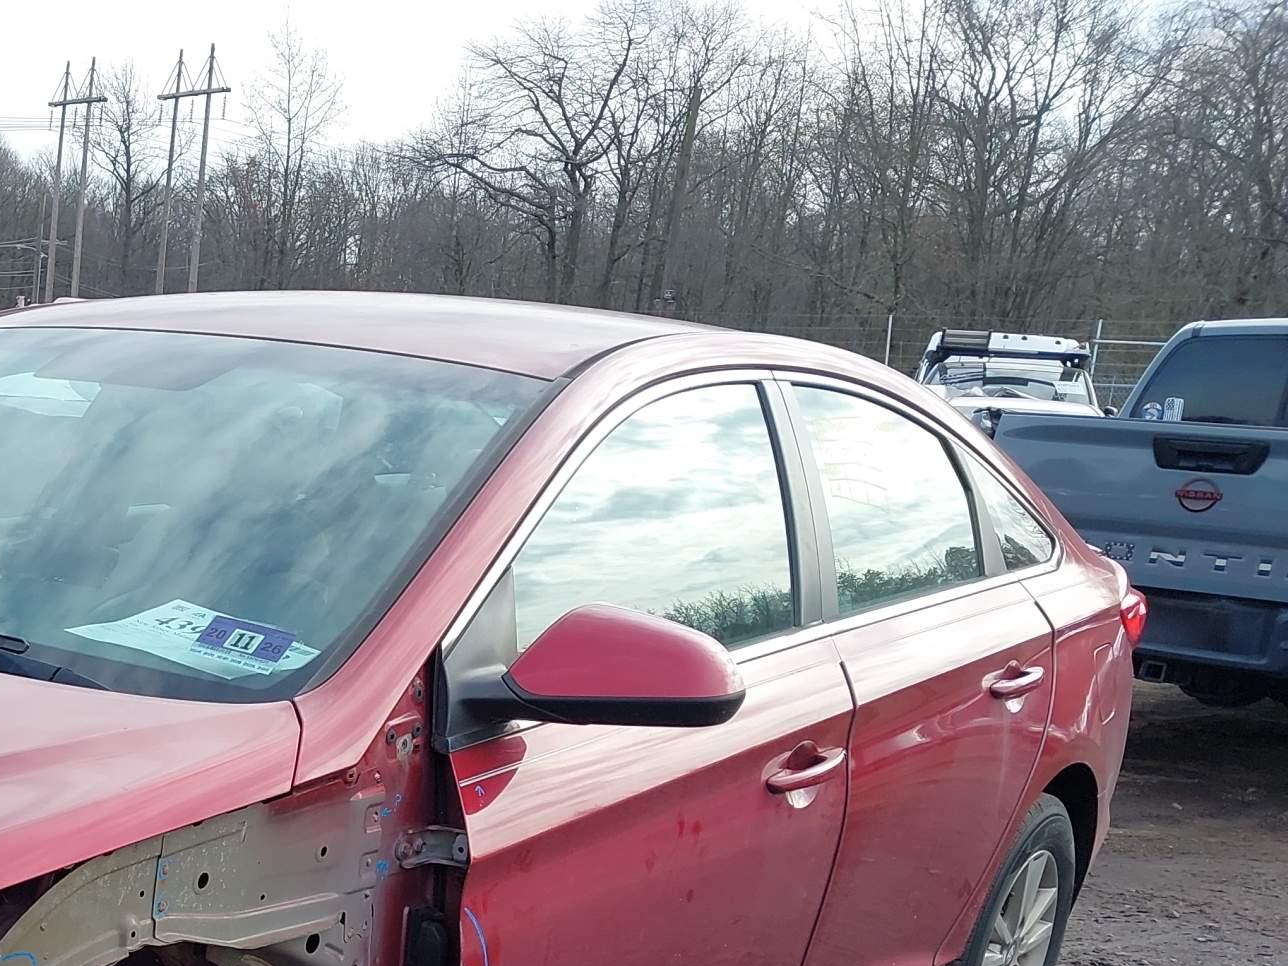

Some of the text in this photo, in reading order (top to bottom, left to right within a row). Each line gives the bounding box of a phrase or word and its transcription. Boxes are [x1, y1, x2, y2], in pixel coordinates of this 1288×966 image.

[1176, 489, 1222, 500] NISSAN
[206, 627, 227, 640] 20
[230, 633, 256, 651] 11
[260, 641, 283, 655] 26
